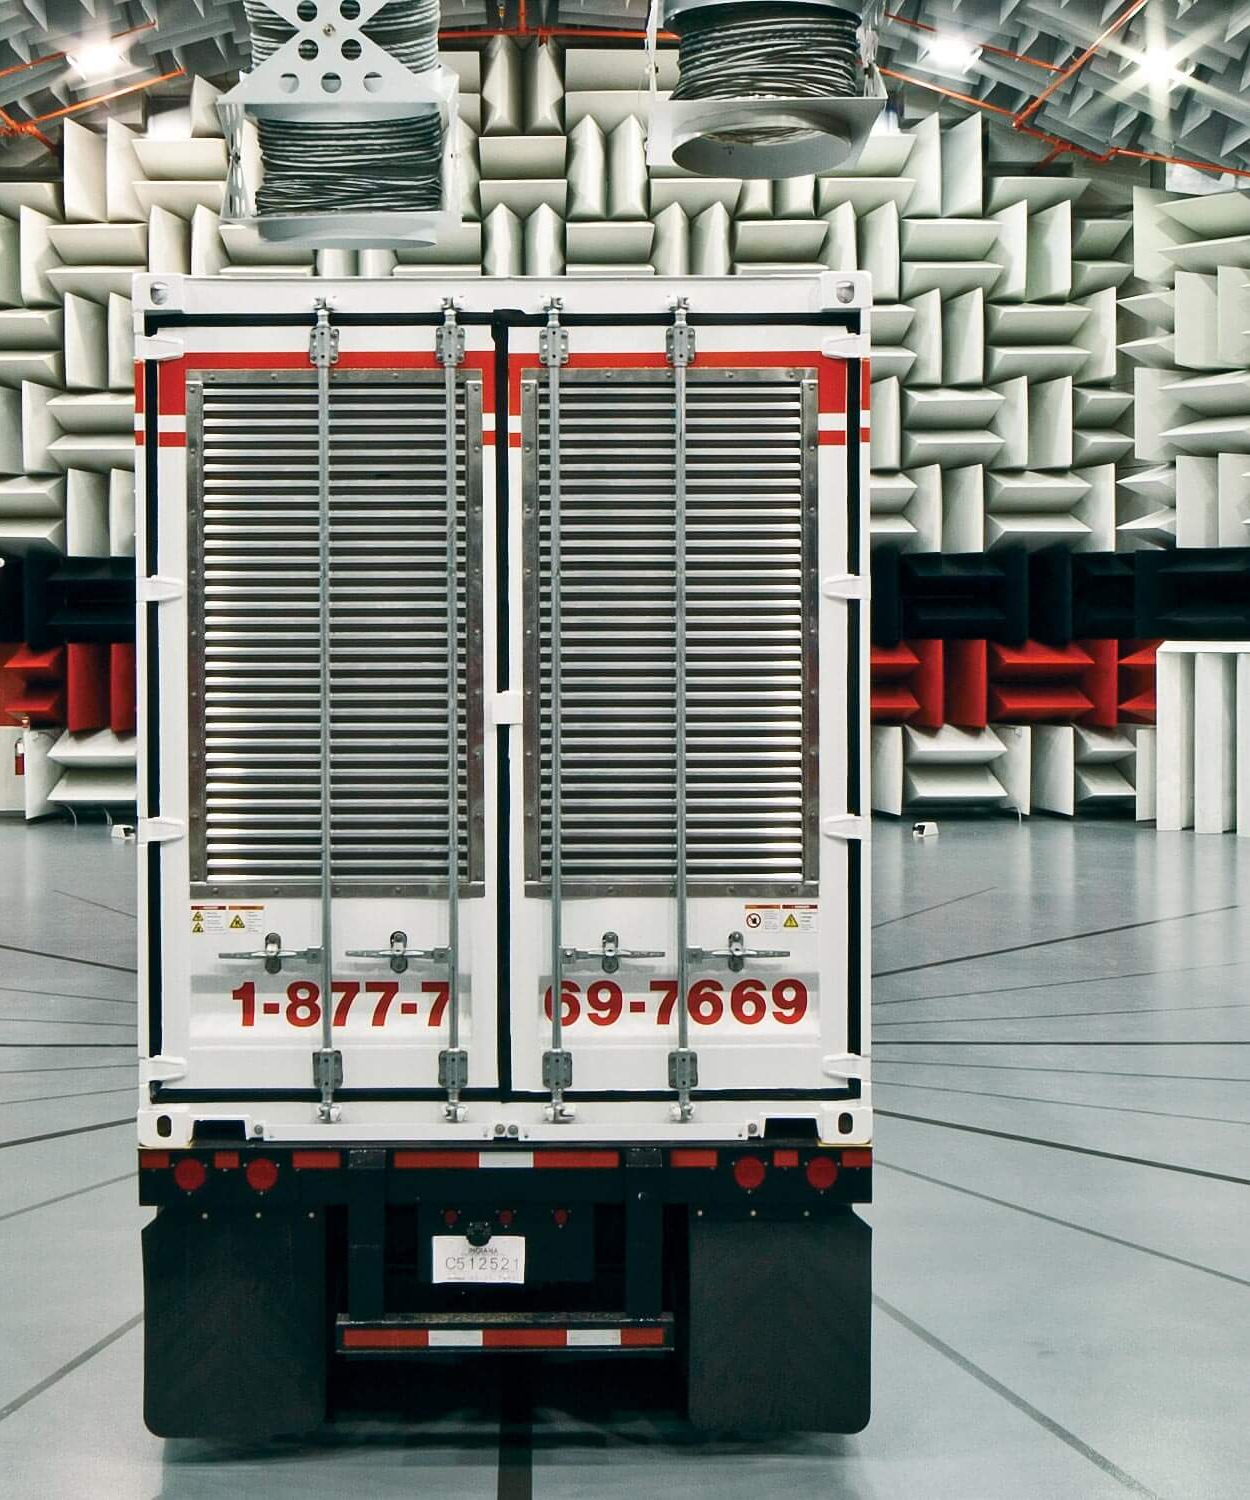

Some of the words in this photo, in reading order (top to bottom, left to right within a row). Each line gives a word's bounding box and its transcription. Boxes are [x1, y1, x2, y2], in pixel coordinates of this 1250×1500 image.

[232, 981, 449, 1027] 1-877-7
[544, 978, 808, 1027] 69-7669
[445, 1256, 519, 1271] C512521
